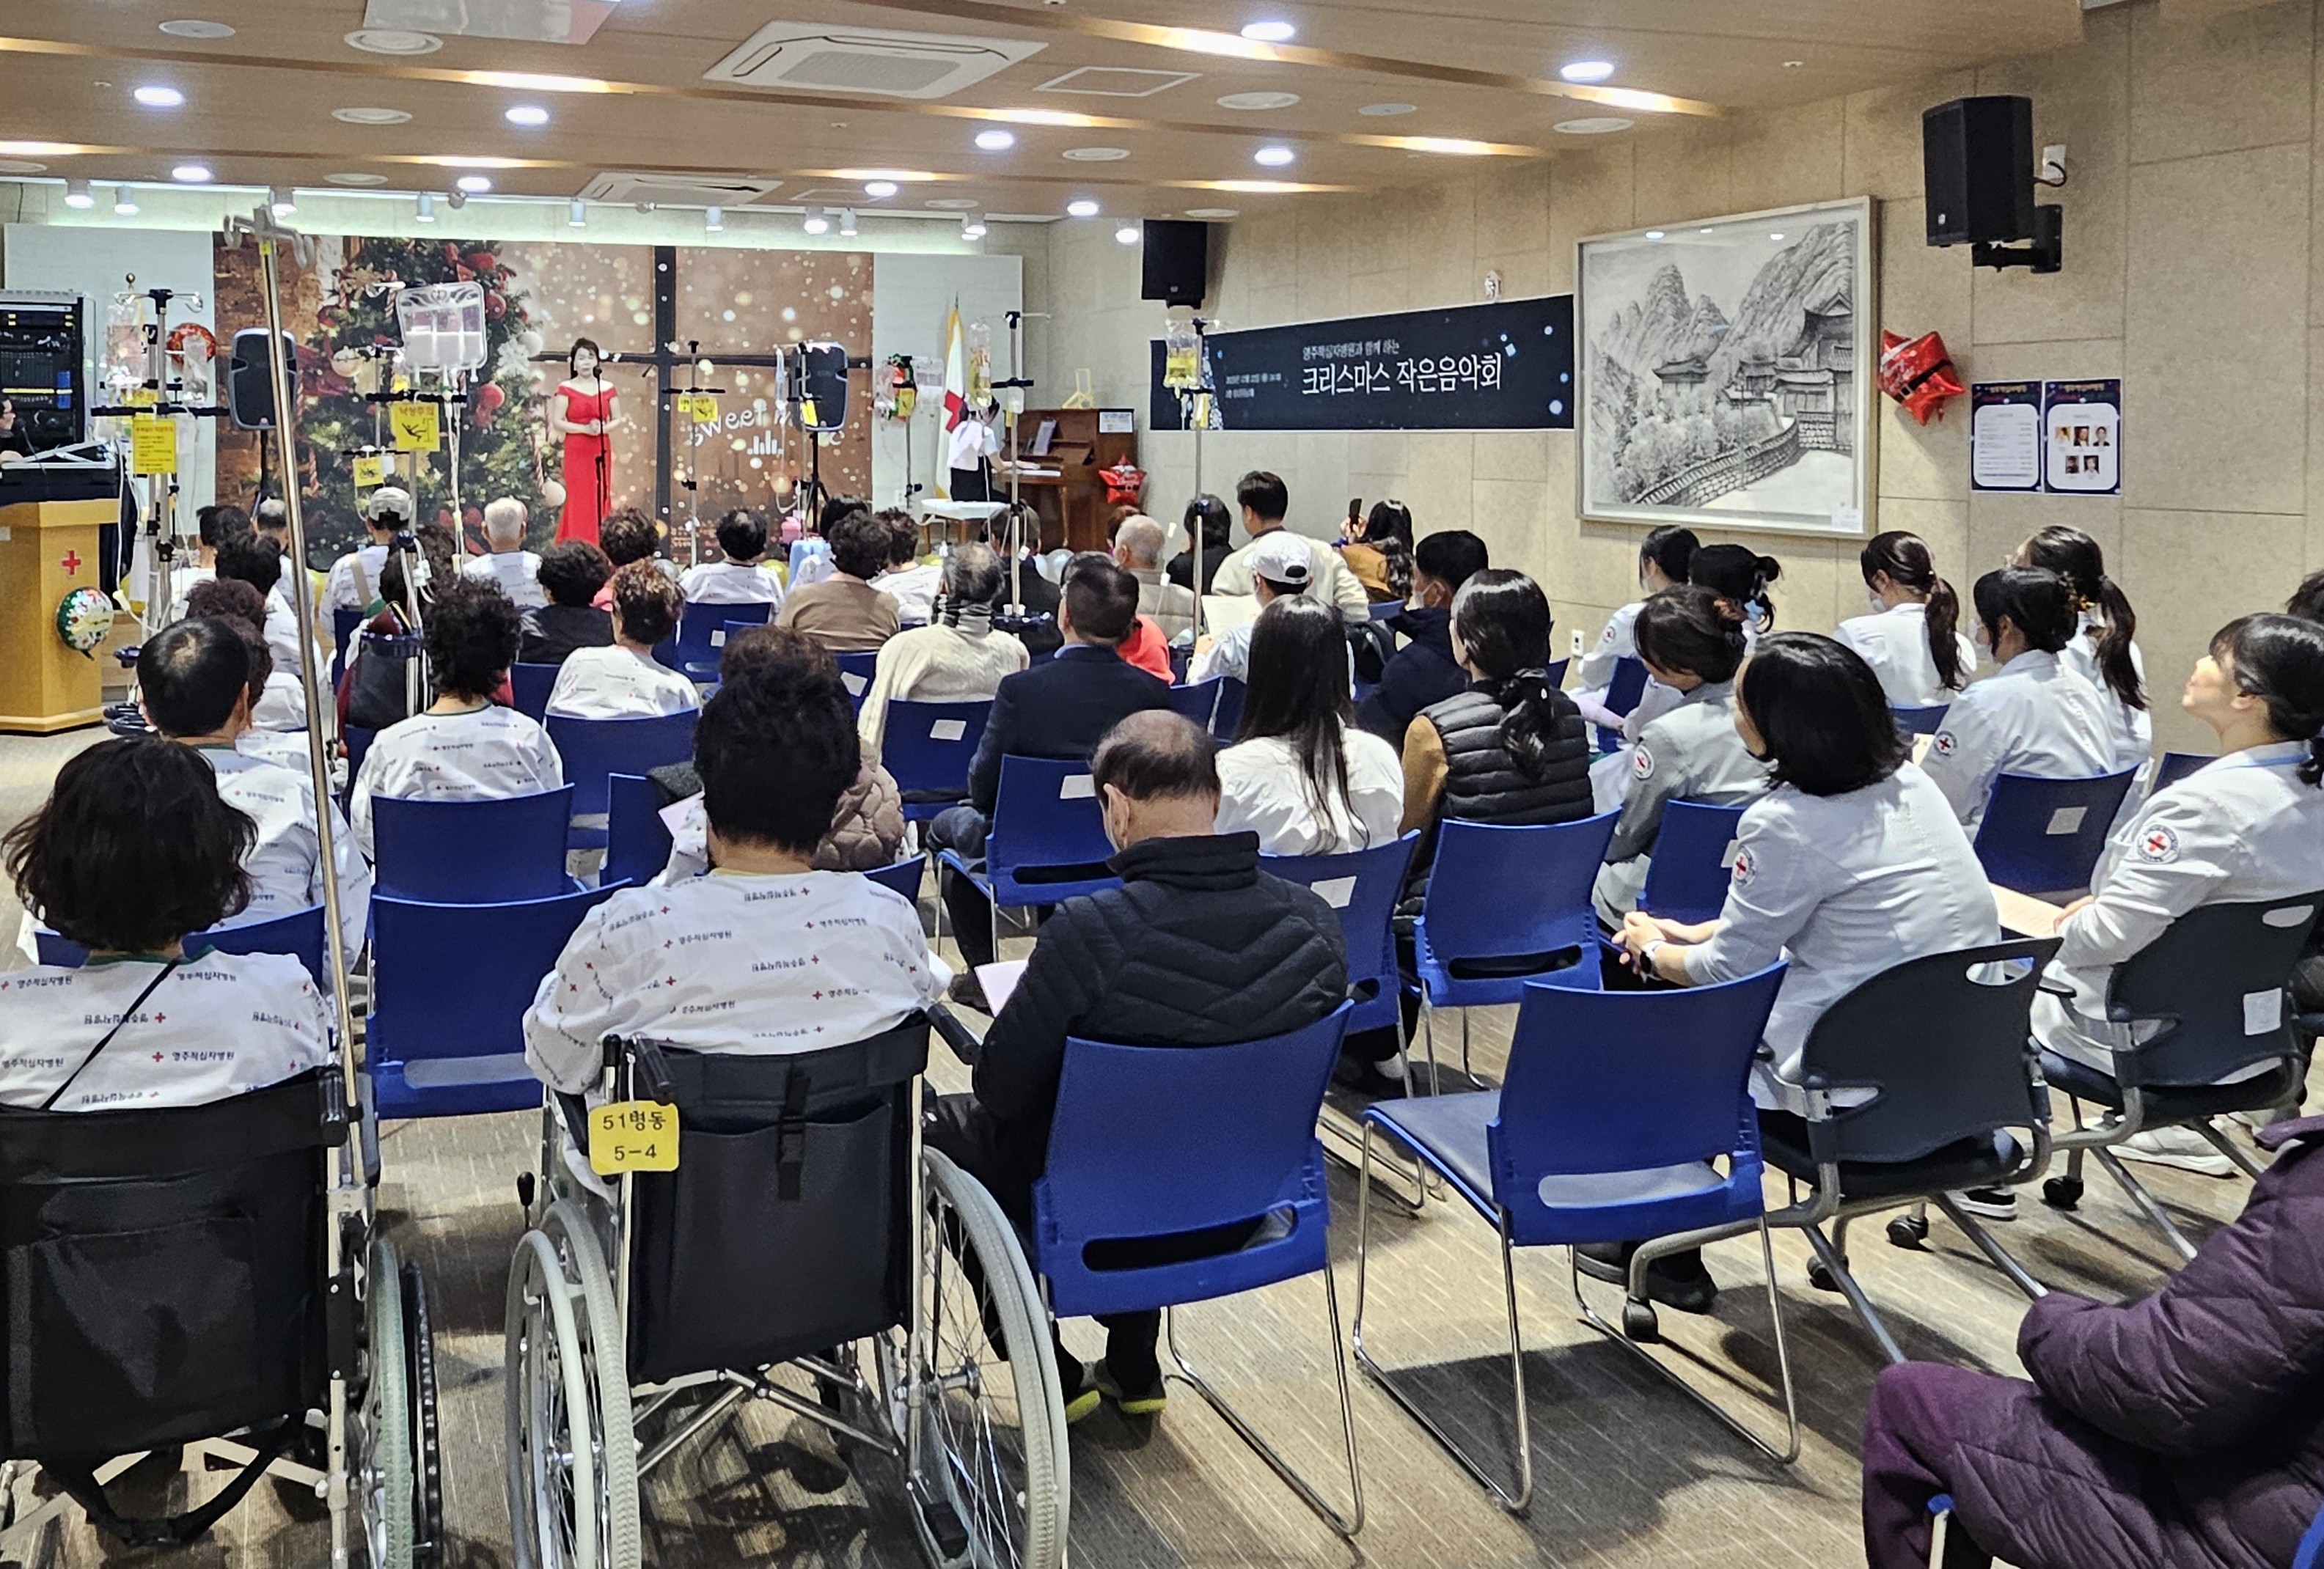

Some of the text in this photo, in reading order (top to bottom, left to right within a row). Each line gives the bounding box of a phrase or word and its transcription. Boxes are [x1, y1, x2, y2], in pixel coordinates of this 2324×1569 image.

[1302, 351, 1502, 395] 크리스마스 작은음악회
[17, 975, 72, 988] 영주적십자병원
[172, 1051, 235, 1061] 영주적십자병원
[603, 1110, 667, 1131] 51병동
[615, 1143, 657, 1161] 5-4
